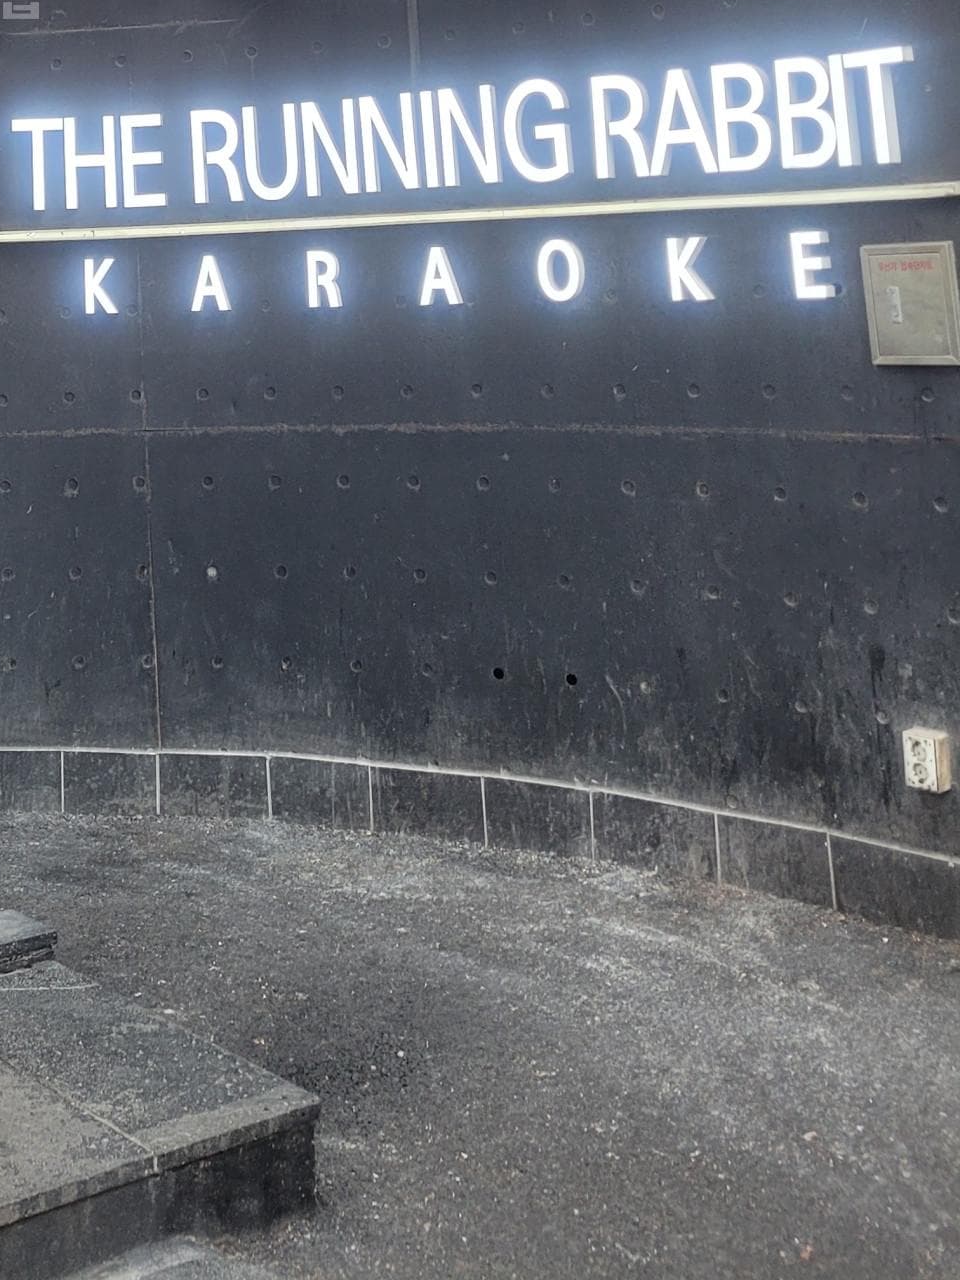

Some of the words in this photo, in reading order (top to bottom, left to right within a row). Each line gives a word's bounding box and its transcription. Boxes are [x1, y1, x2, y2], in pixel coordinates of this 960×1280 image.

[11, 113, 168, 211] THE
[190, 77, 573, 204] RUNNING
[590, 46, 913, 179] RABBIT
[83, 231, 836, 315] KARAOKE
